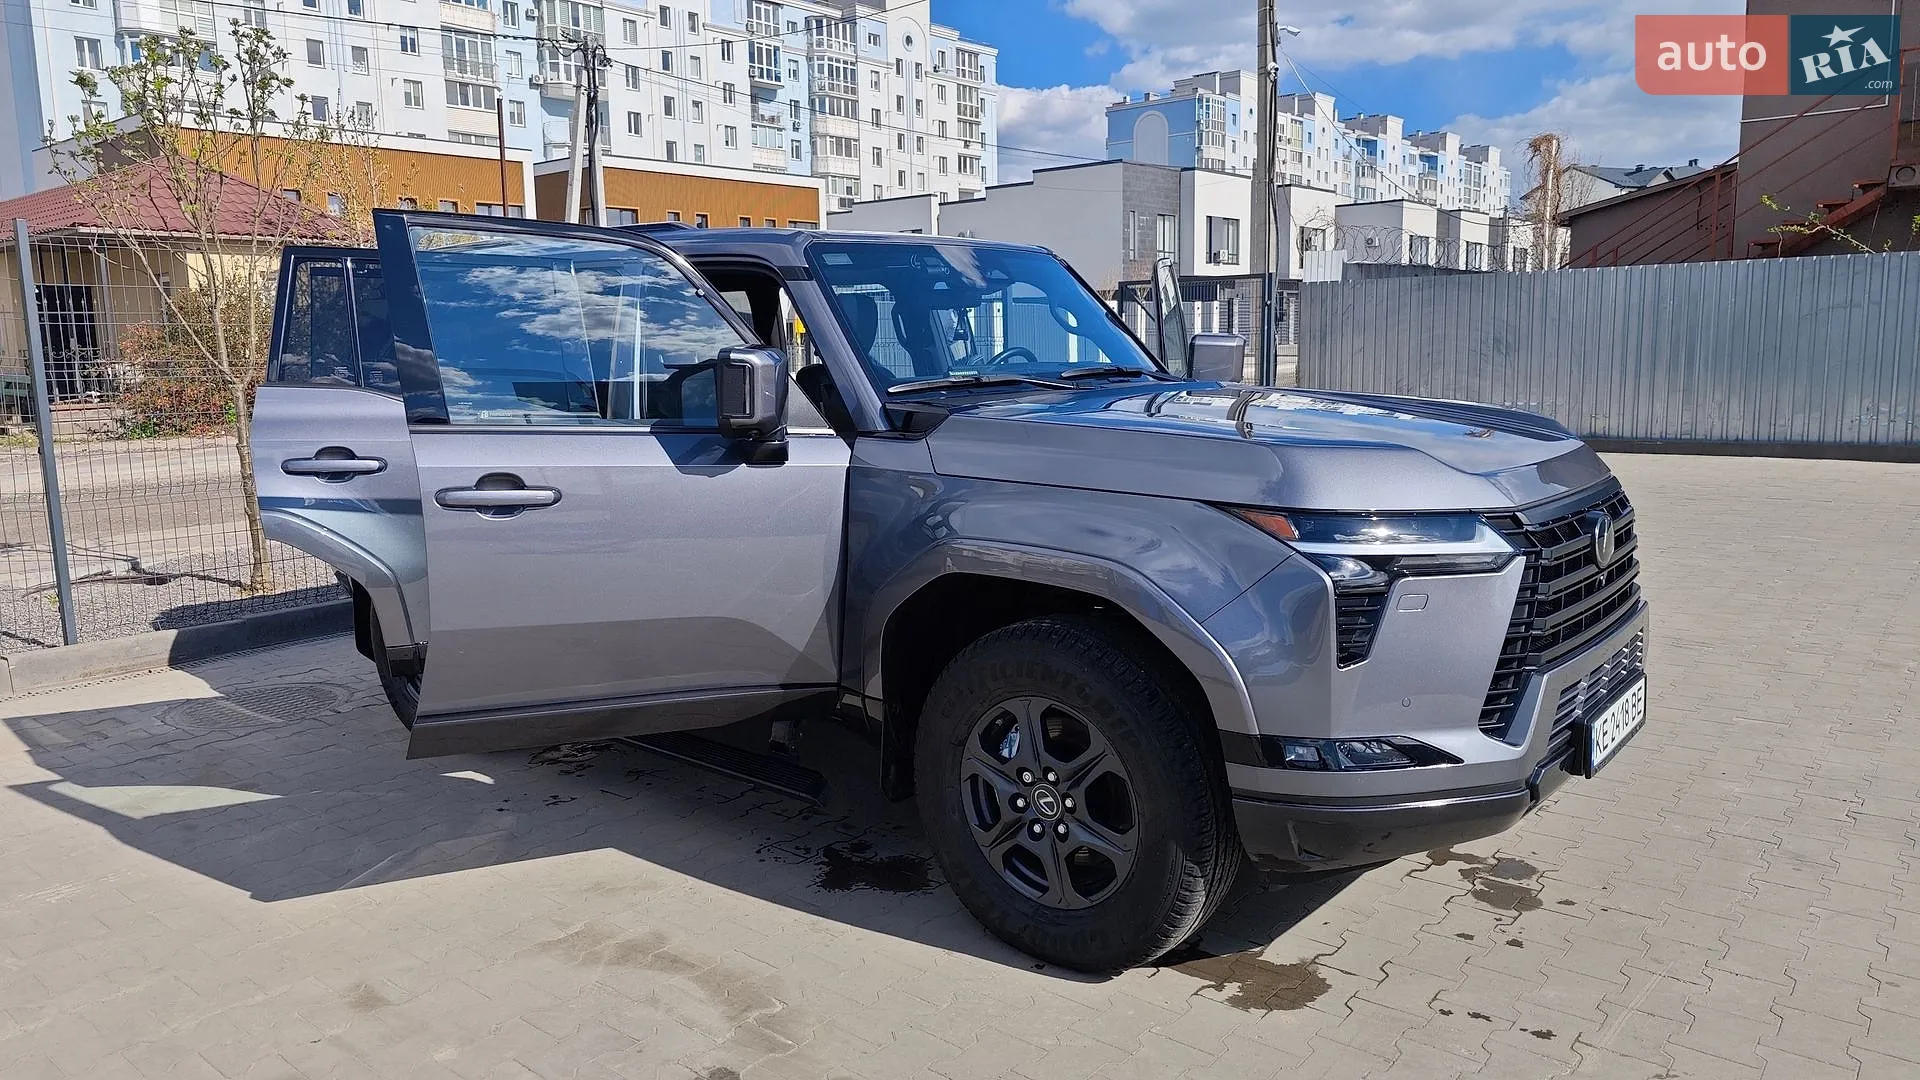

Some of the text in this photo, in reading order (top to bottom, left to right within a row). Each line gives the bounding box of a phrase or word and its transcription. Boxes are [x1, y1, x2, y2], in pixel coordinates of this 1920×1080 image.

[1595, 718, 1609, 758] KE
[1610, 699, 1630, 743] 2418
[1631, 687, 1643, 722] BE
